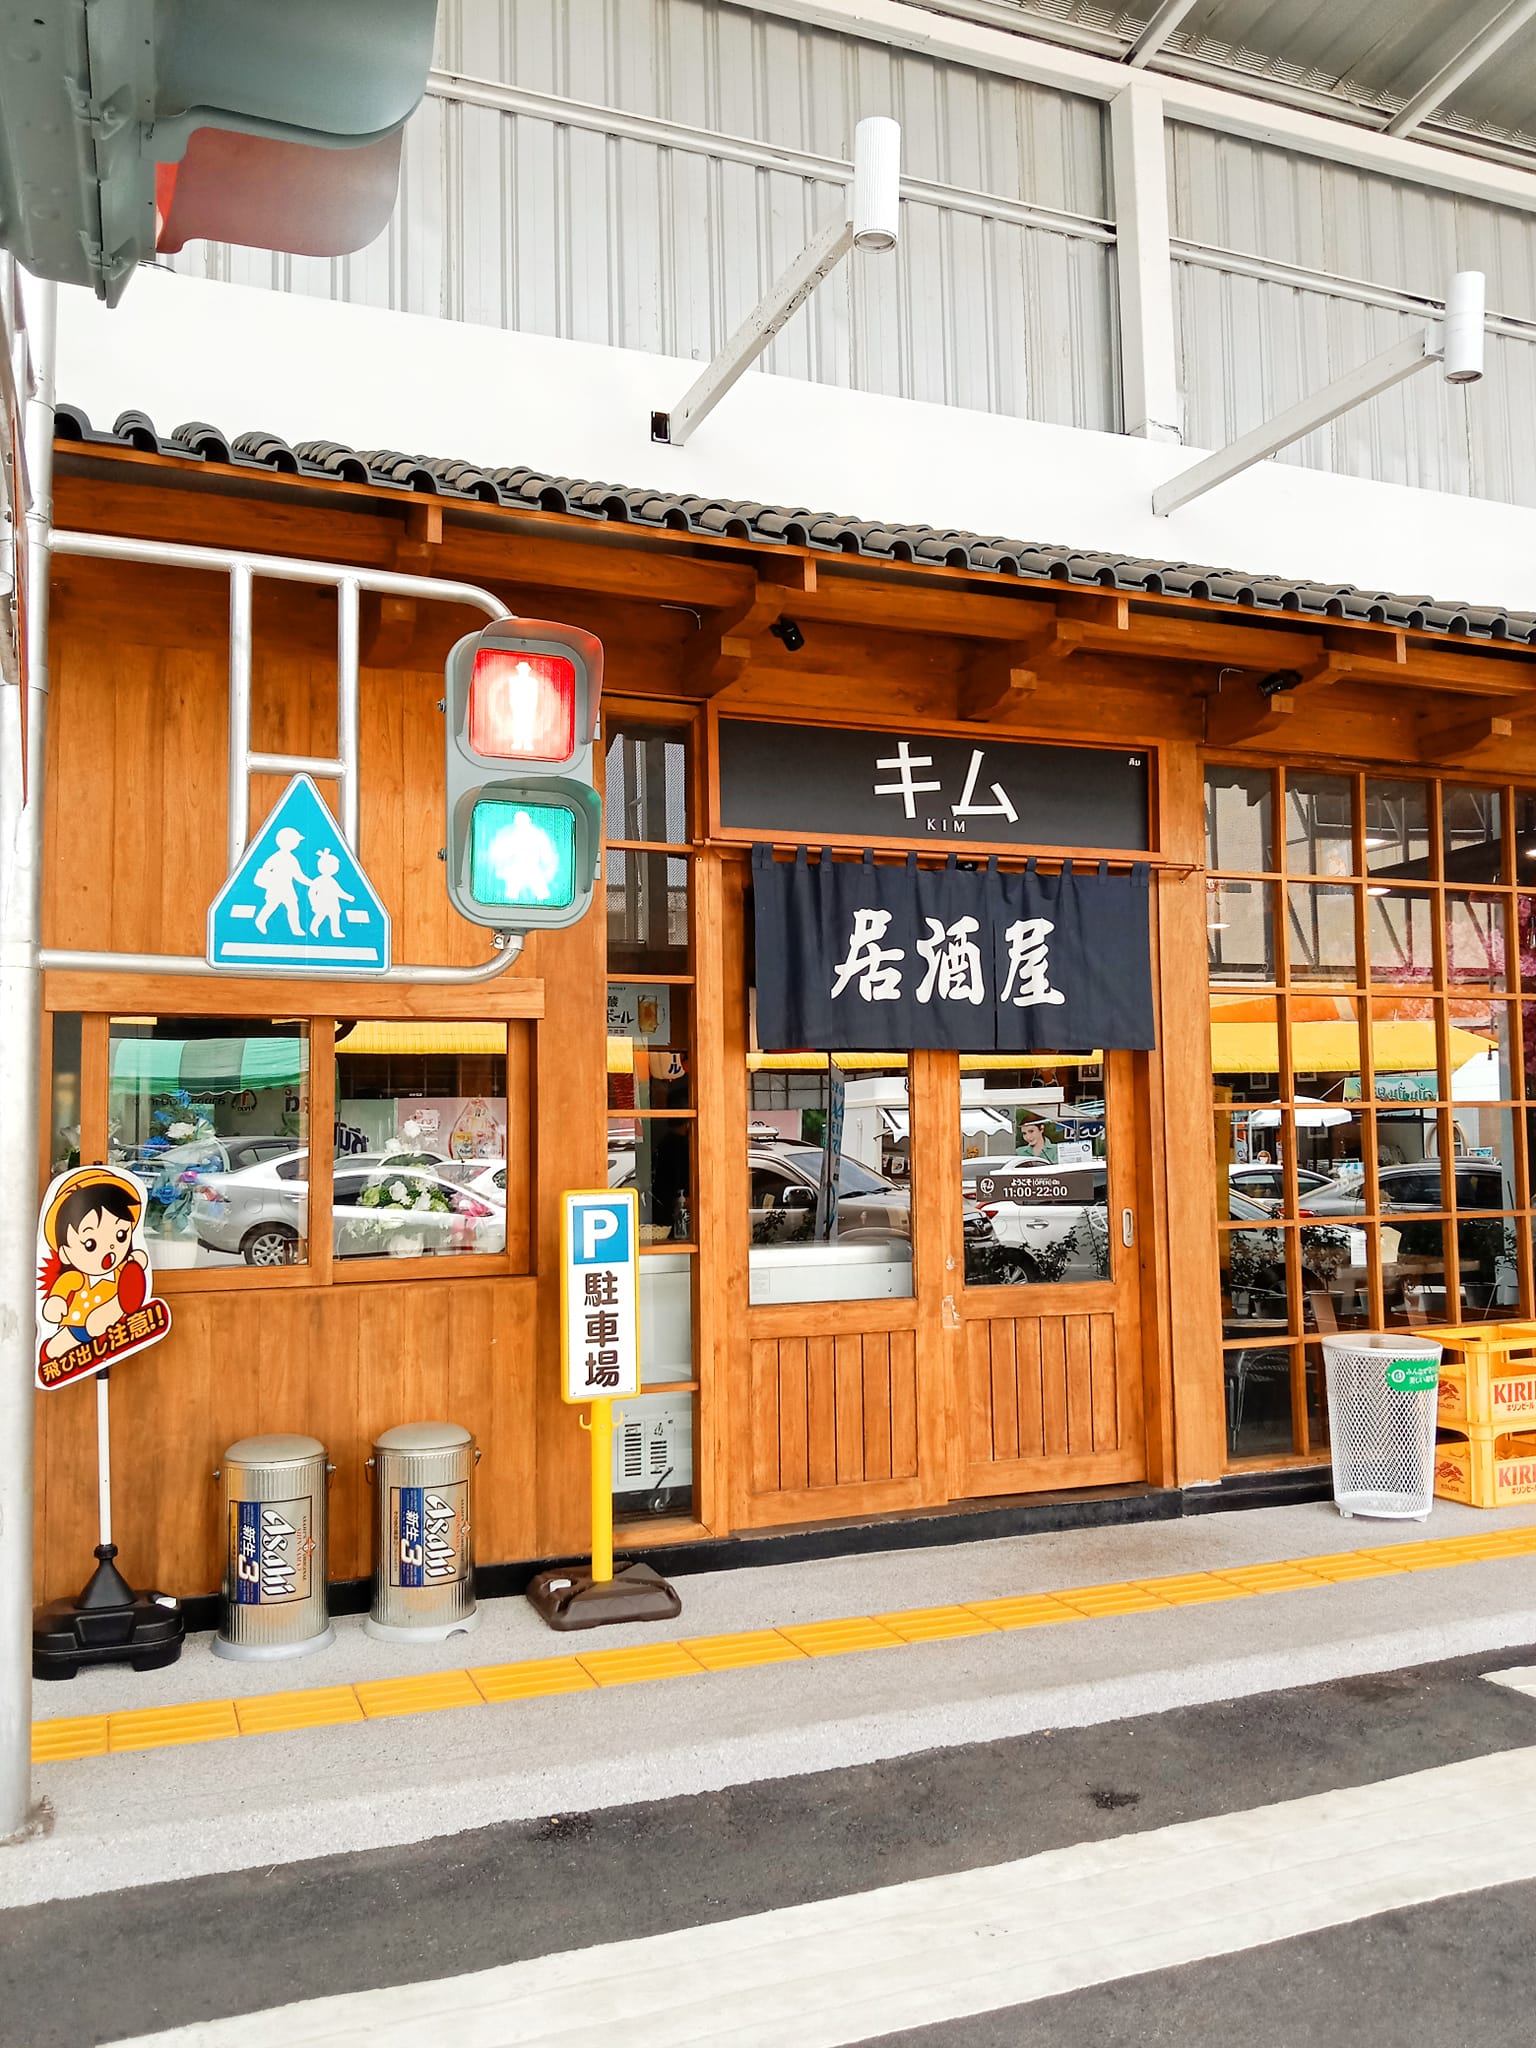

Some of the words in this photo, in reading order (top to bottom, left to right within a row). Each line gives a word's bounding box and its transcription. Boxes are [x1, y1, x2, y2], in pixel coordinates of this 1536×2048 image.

[873, 741, 1020, 824] キム
[926, 818, 966, 833] KIM
[830, 907, 1066, 1008] 居酒屋
[1003, 1186, 1068, 1198] 11:00-22:00
[583, 1209, 619, 1259] P
[584, 1270, 620, 1388] 駐車場
[1494, 1381, 1536, 1405] KIRI
[262, 1509, 297, 1597] Asahi
[425, 1494, 456, 1577] Asahi
